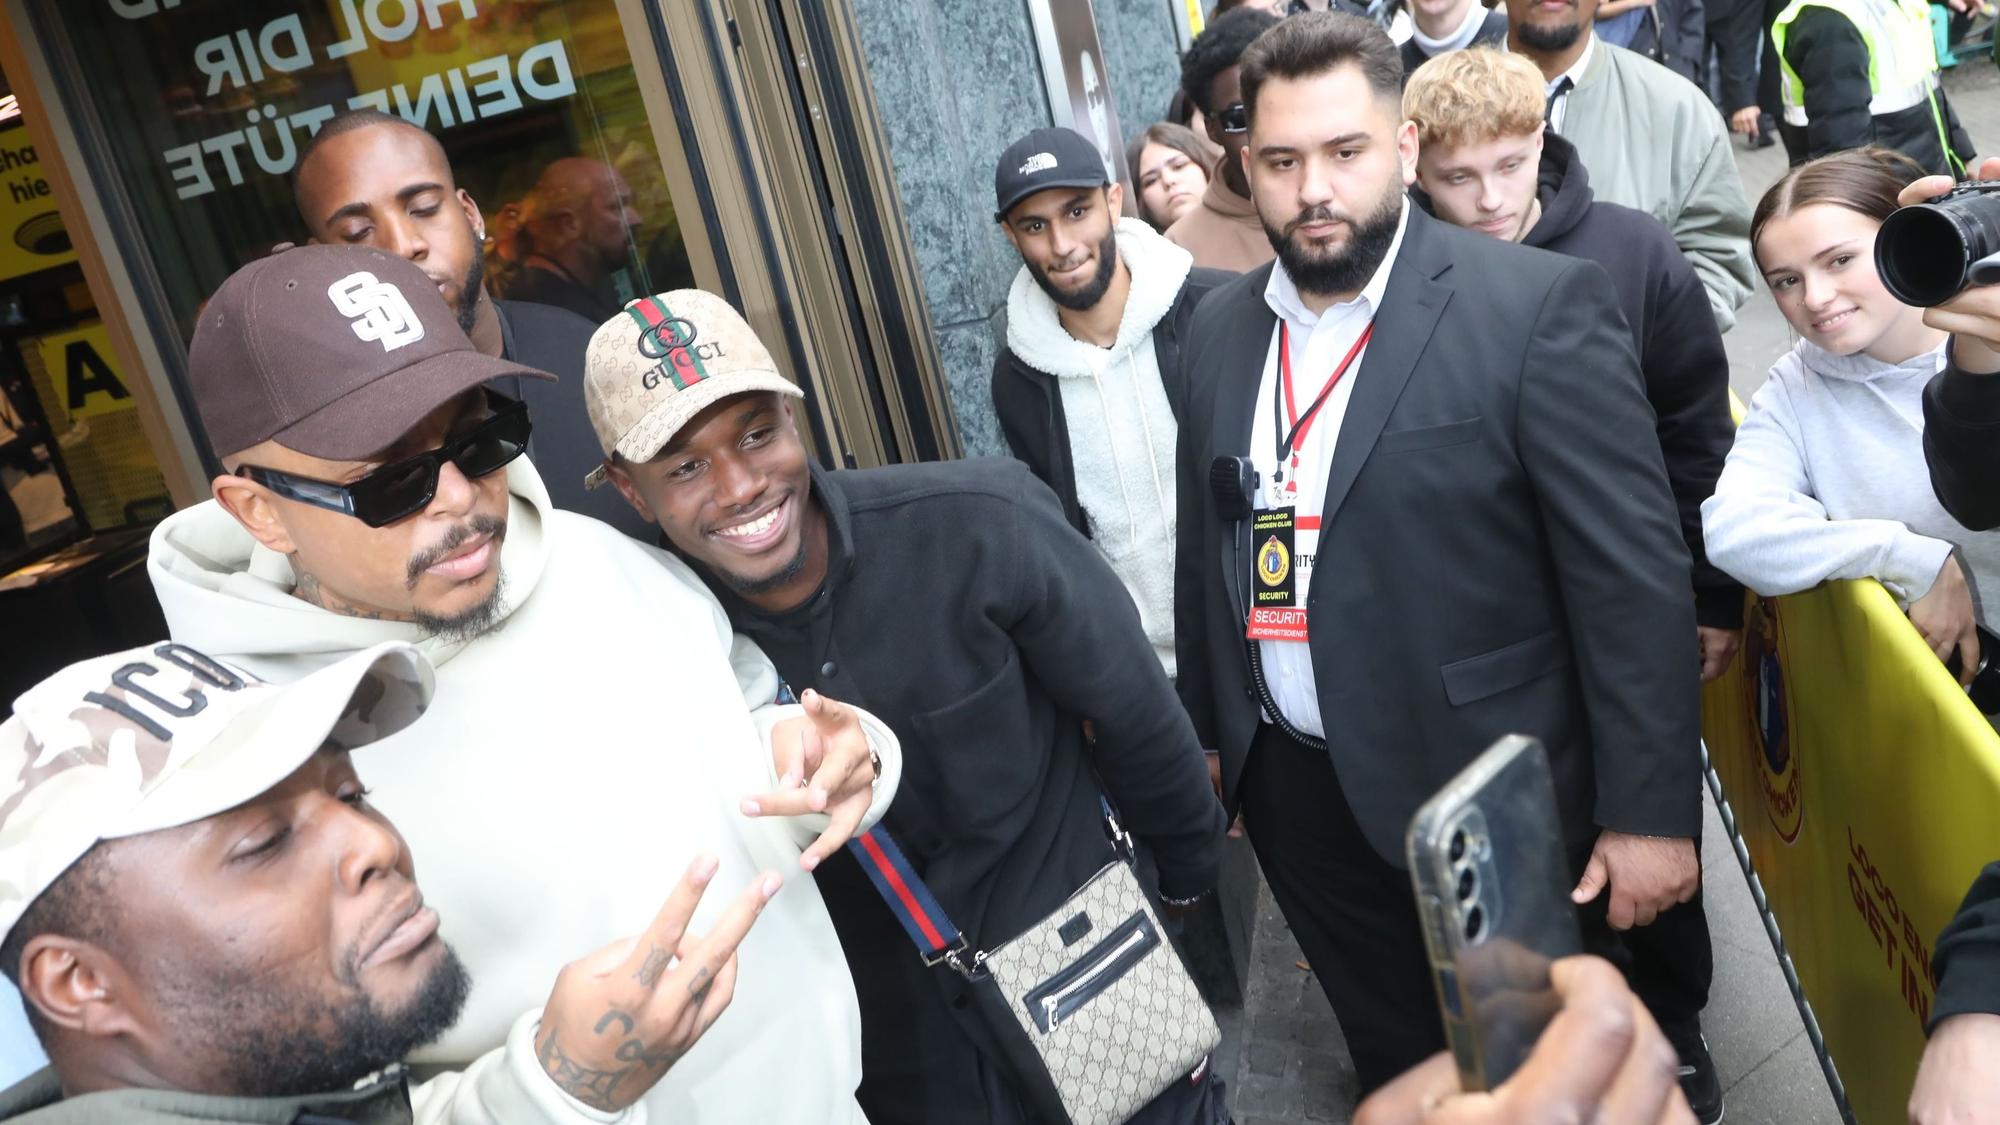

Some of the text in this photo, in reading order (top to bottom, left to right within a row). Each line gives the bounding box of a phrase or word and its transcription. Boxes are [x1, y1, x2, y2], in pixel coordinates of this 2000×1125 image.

[642, 341, 726, 390] GUCCI
[1254, 610, 1307, 625] SECURITY
[1258, 591, 1289, 600] SECURITY
[1848, 824, 1900, 925] LOCO
[1848, 862, 1898, 971] GET
